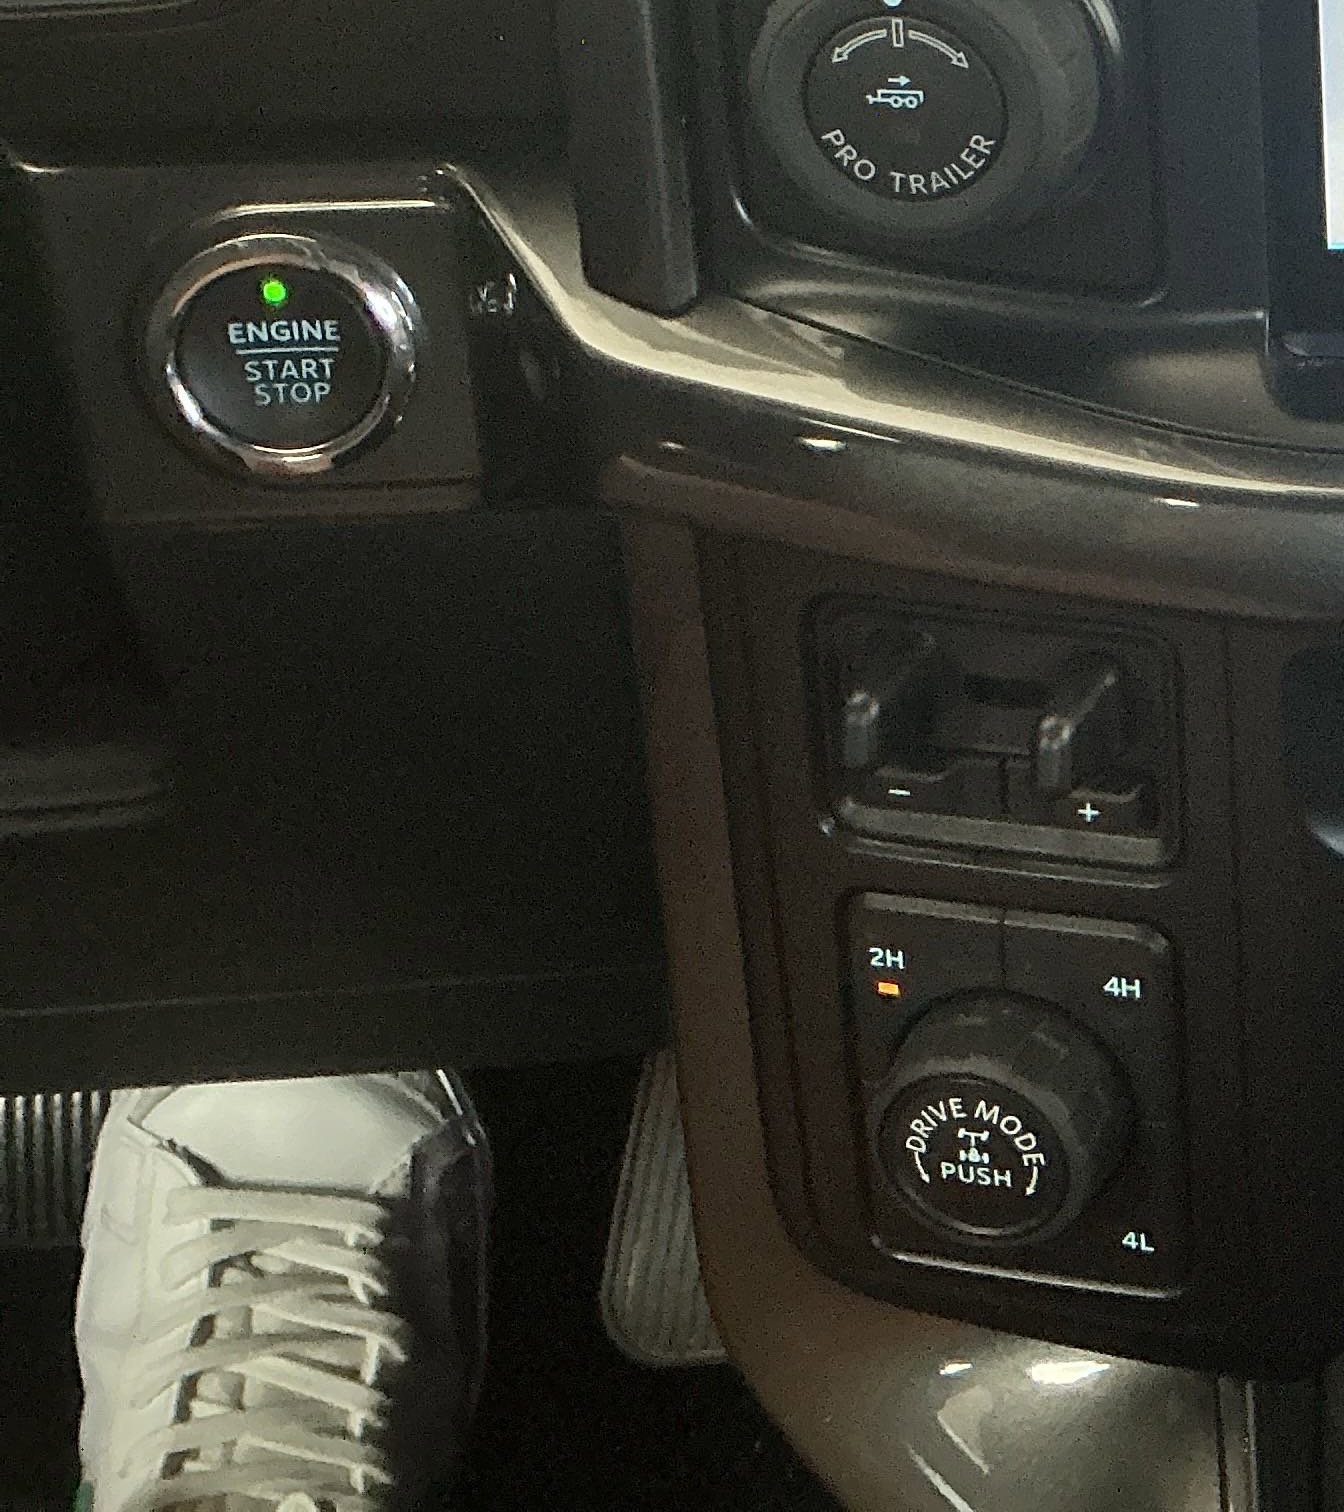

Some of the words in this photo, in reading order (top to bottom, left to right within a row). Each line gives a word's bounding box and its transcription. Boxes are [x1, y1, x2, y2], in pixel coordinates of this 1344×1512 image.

[820, 128, 876, 182] PRO
[888, 132, 997, 196] TRAILER
[227, 320, 341, 344] ENGINE
[244, 358, 336, 382] START
[253, 382, 332, 407] STOP
[869, 947, 905, 970] 2H
[1103, 976, 1142, 999] 4H
[905, 1097, 966, 1154] DRIVE
[974, 1099, 1046, 1167] MODE
[940, 1161, 1012, 1188] PUSH
[1121, 1231, 1155, 1253] 4L
